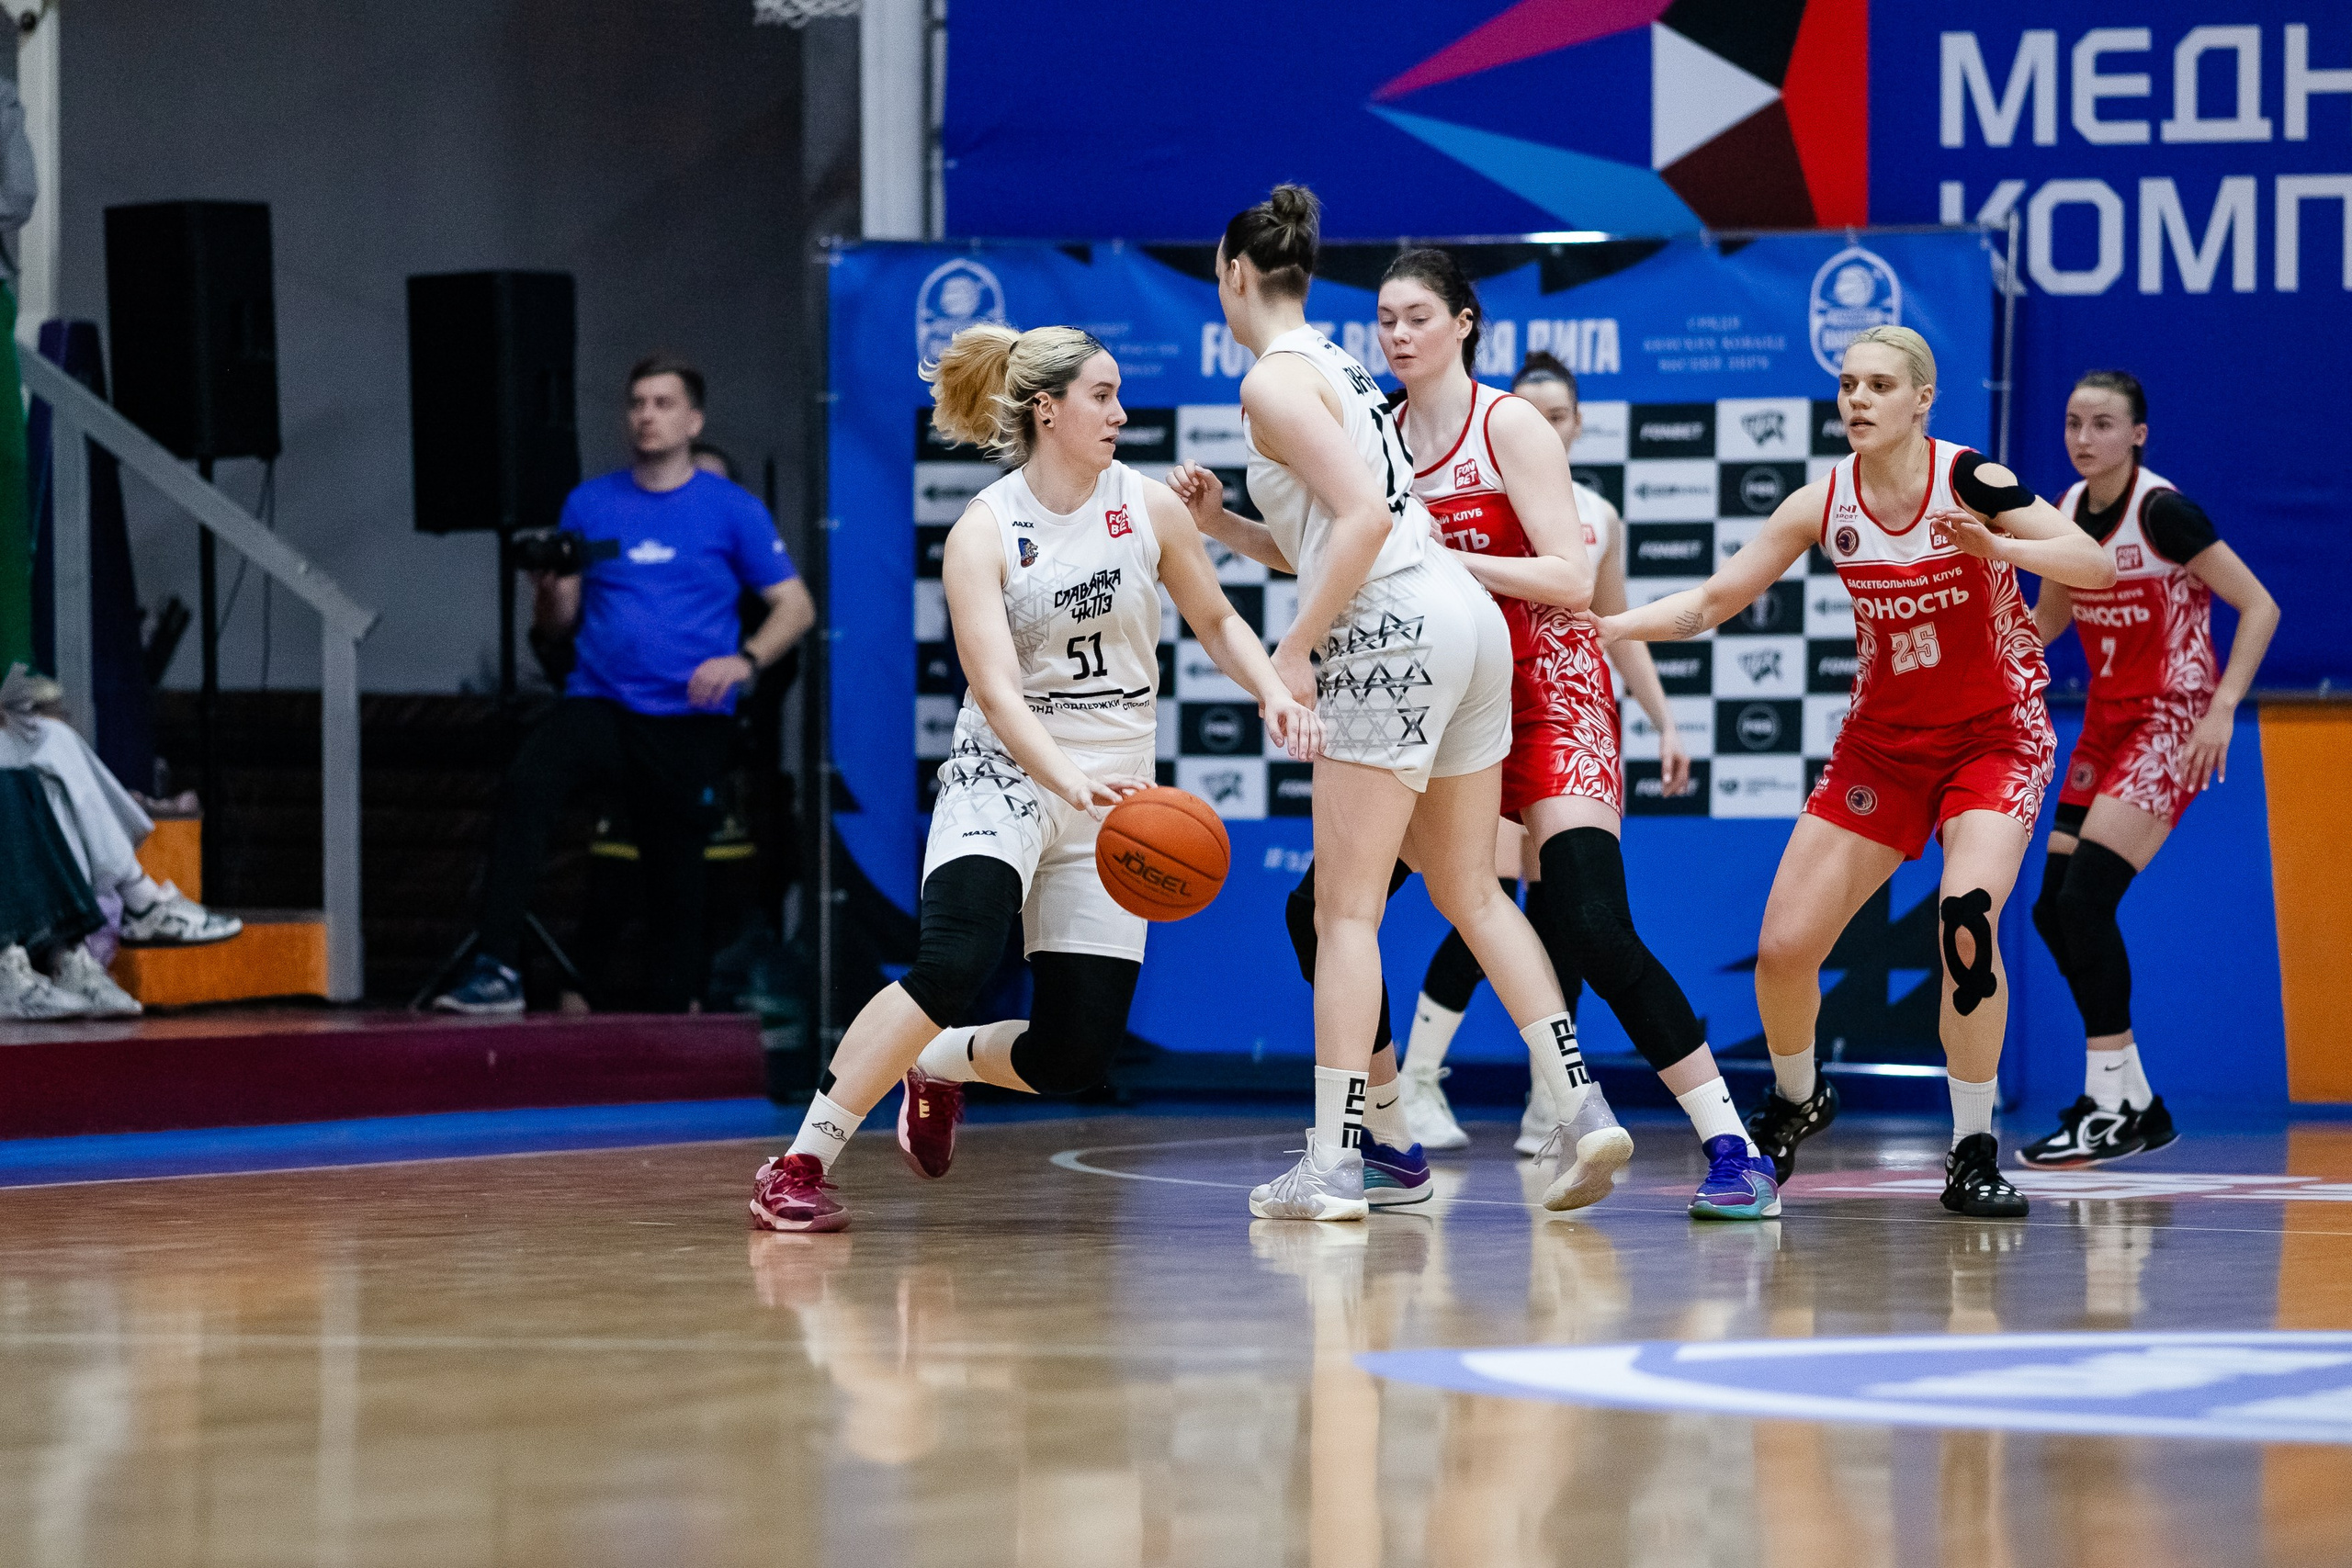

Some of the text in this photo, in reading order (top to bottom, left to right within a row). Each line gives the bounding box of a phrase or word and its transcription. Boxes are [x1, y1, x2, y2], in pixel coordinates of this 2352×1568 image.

[1456, 460, 1476, 478] FON
[1456, 471, 1476, 488] BET
[1453, 508, 1484, 522] КЛУБ
[1443, 527, 1490, 551] СТЬ
[1933, 534, 1948, 547] BE
[1847, 566, 1963, 590] БАСКЕТБОЛЬНЫЙ КЛУБ
[1067, 631, 1108, 681] 51
[1888, 621, 1941, 676] 25
[2099, 637, 2117, 678] 7
[1029, 704, 1054, 716] ОНД
[1055, 699, 1120, 710] ПОДДЕРЖКИ
[961, 829, 998, 838] MAXX
[1112, 850, 1193, 897] JÖGEL
